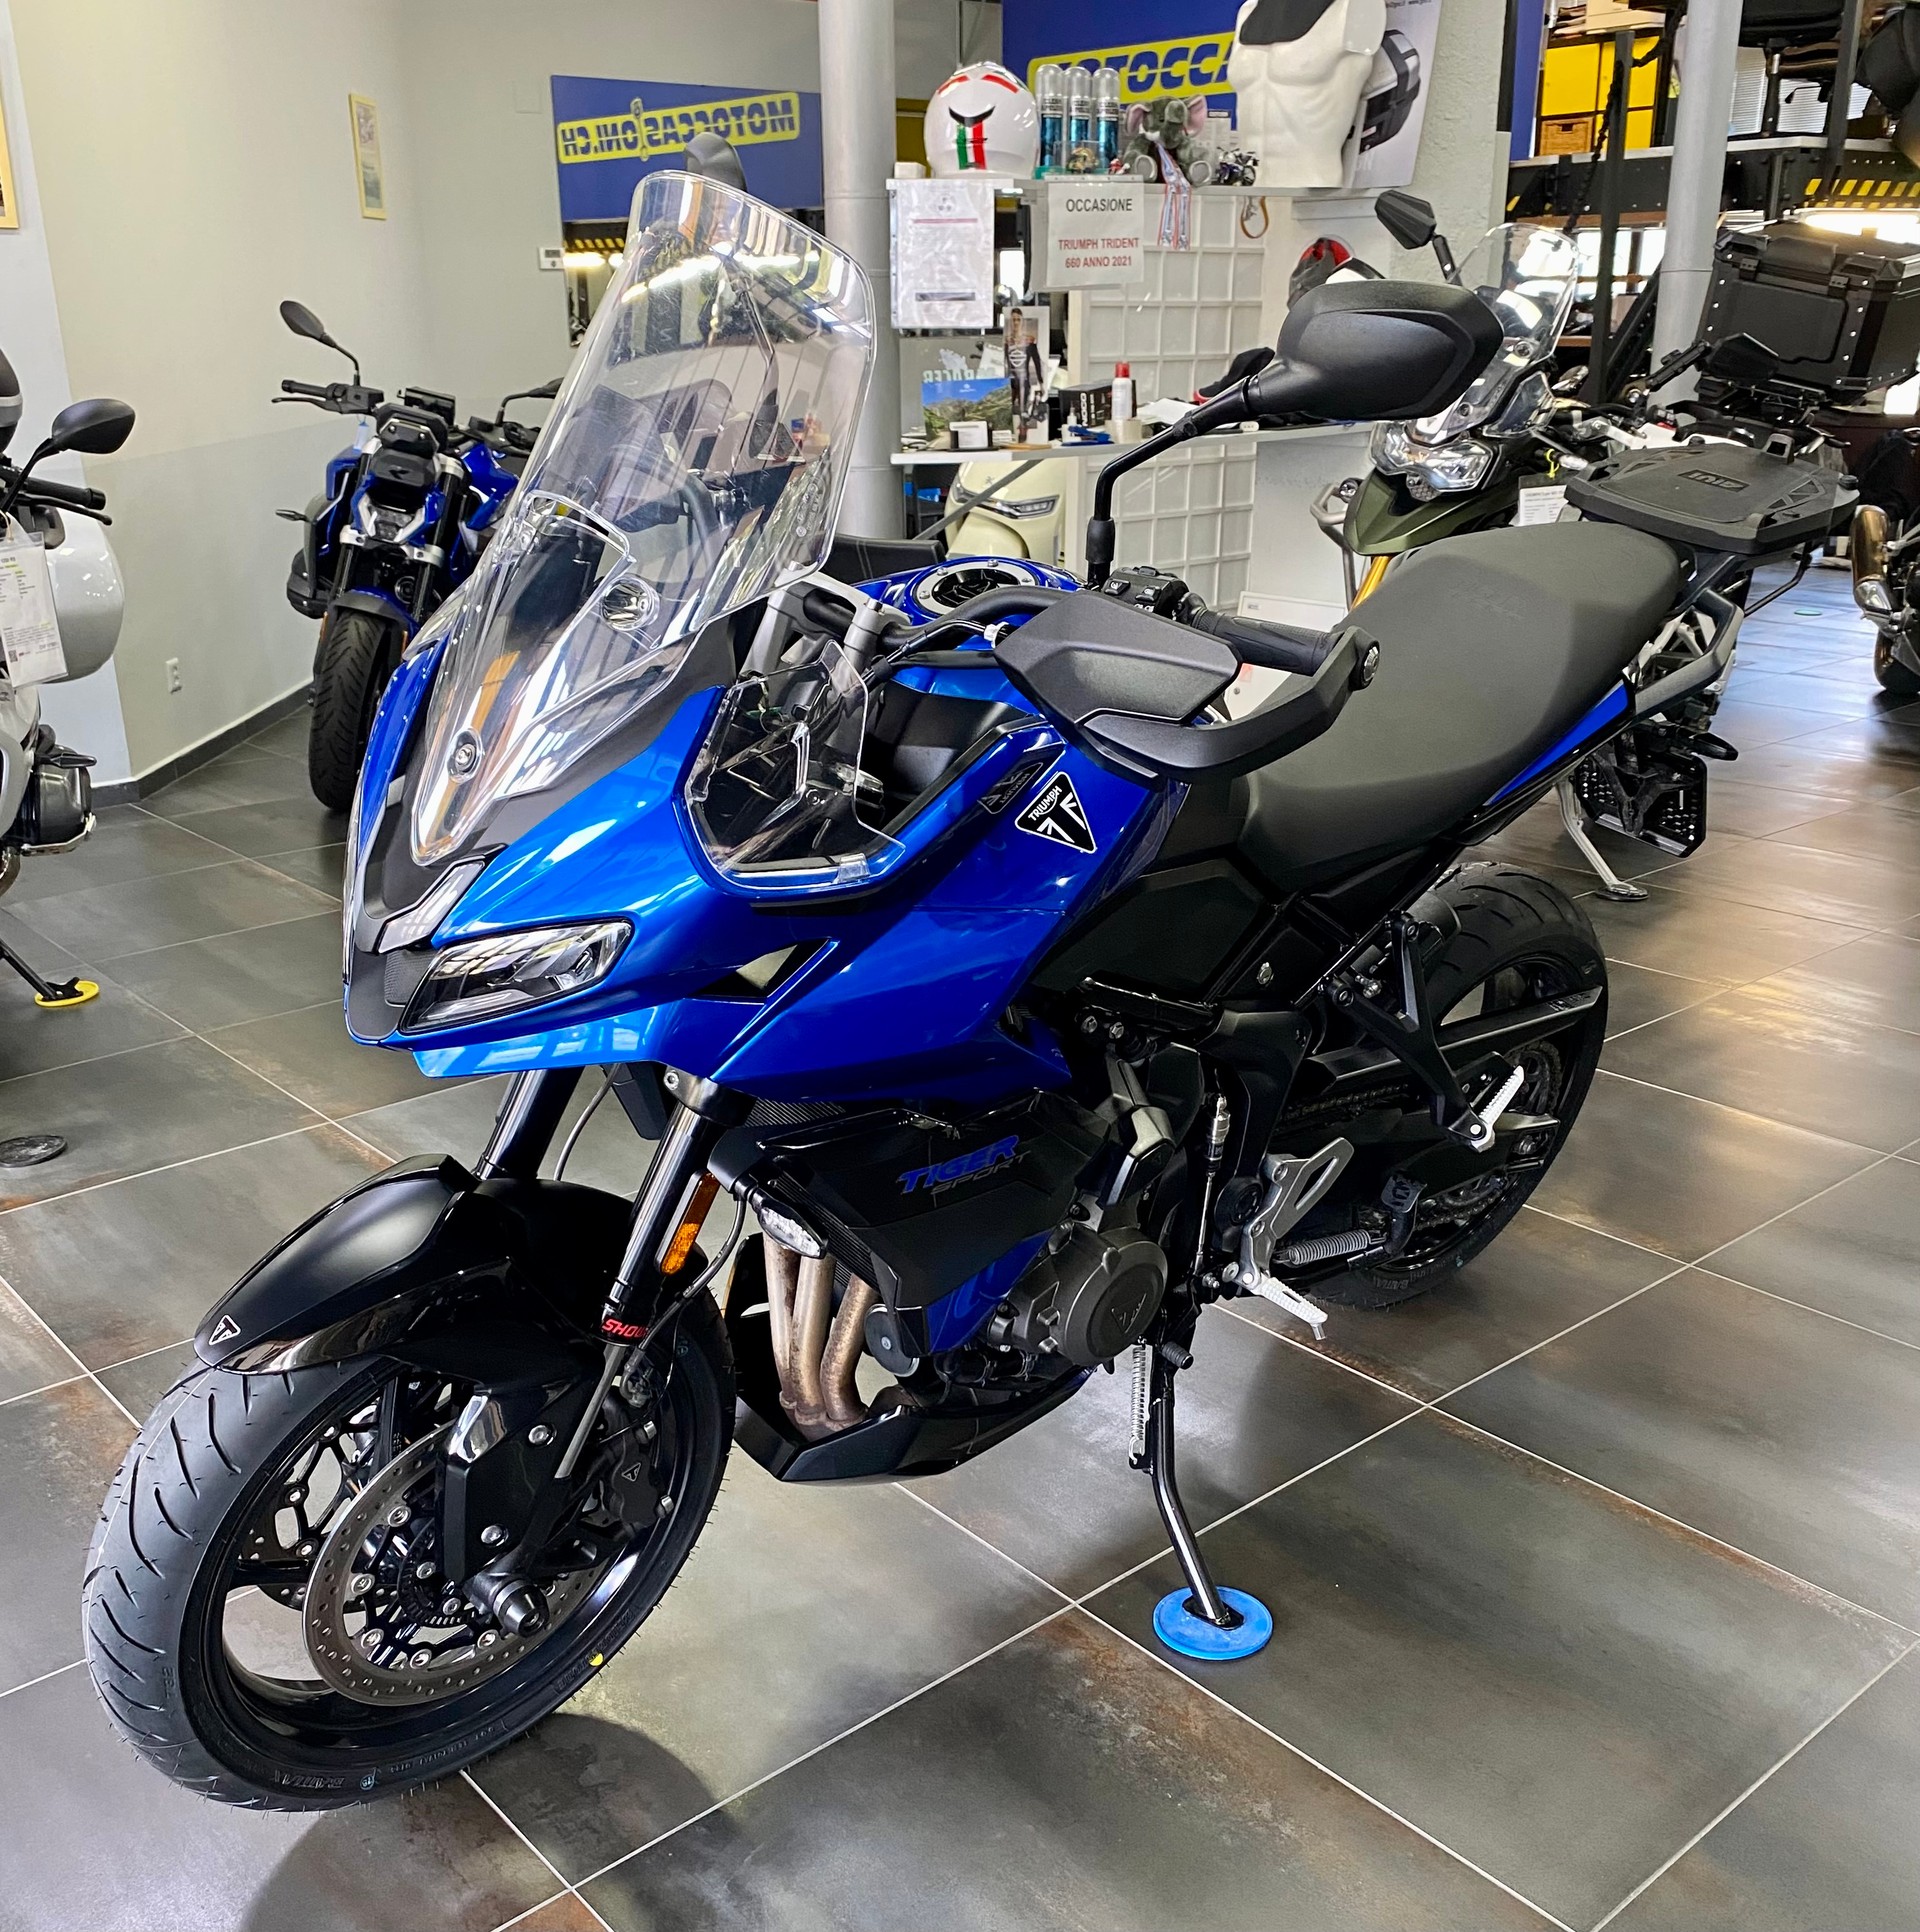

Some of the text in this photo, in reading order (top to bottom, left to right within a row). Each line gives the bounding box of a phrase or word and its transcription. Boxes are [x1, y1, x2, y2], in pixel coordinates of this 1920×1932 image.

[1066, 199, 1133, 212] OCCASIONE
[1059, 238, 1139, 250] TRIUMPH TRIDENT
[1065, 256, 1132, 269] 660 ANNO 2021
[1080, 392, 1089, 427] NOCO
[1027, 786, 1063, 821] TRIUMPH
[897, 1135, 1020, 1194] TIGER
[930, 1150, 1032, 1195] SPORT
